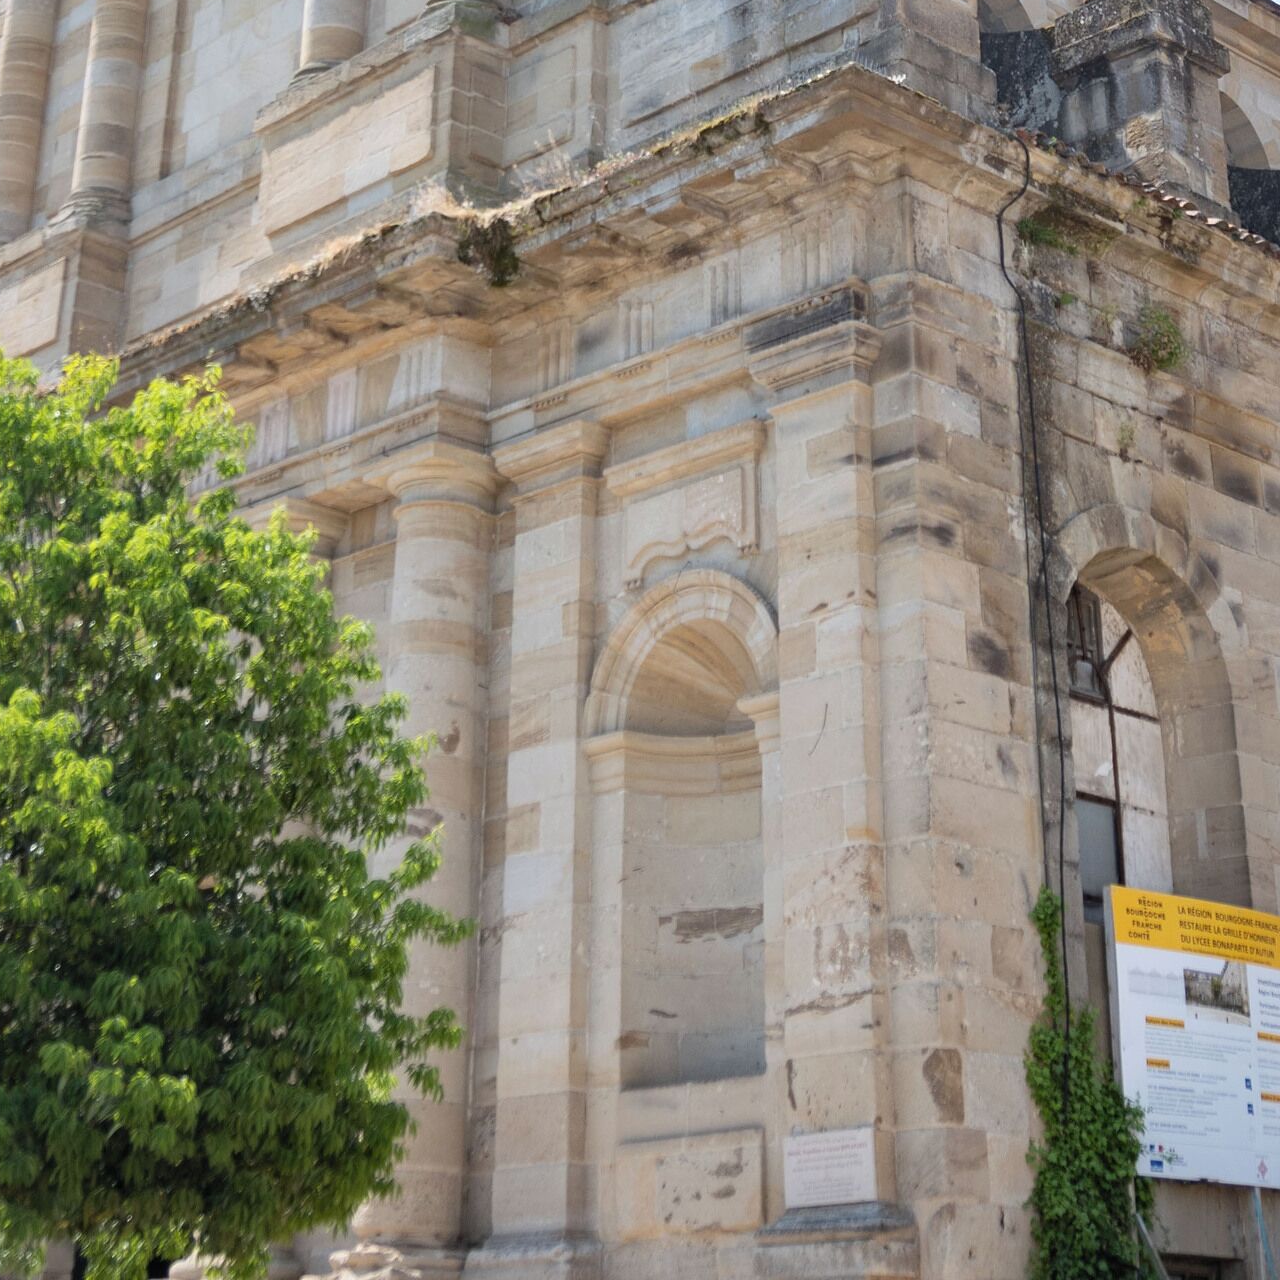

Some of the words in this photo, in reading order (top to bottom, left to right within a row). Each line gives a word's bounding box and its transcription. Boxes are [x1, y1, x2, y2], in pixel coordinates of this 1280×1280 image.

[1177, 905, 1186, 916] LA
[1179, 920, 1212, 934] RESTAURE
[1213, 926, 1222, 936] LA
[1222, 927, 1243, 940] GRILLE
[1243, 930, 1277, 946] D'HONNEUR
[1180, 934, 1191, 945] DU
[1212, 939, 1249, 955] BONAPARTE
[1249, 944, 1275, 960] D'AUTUN
